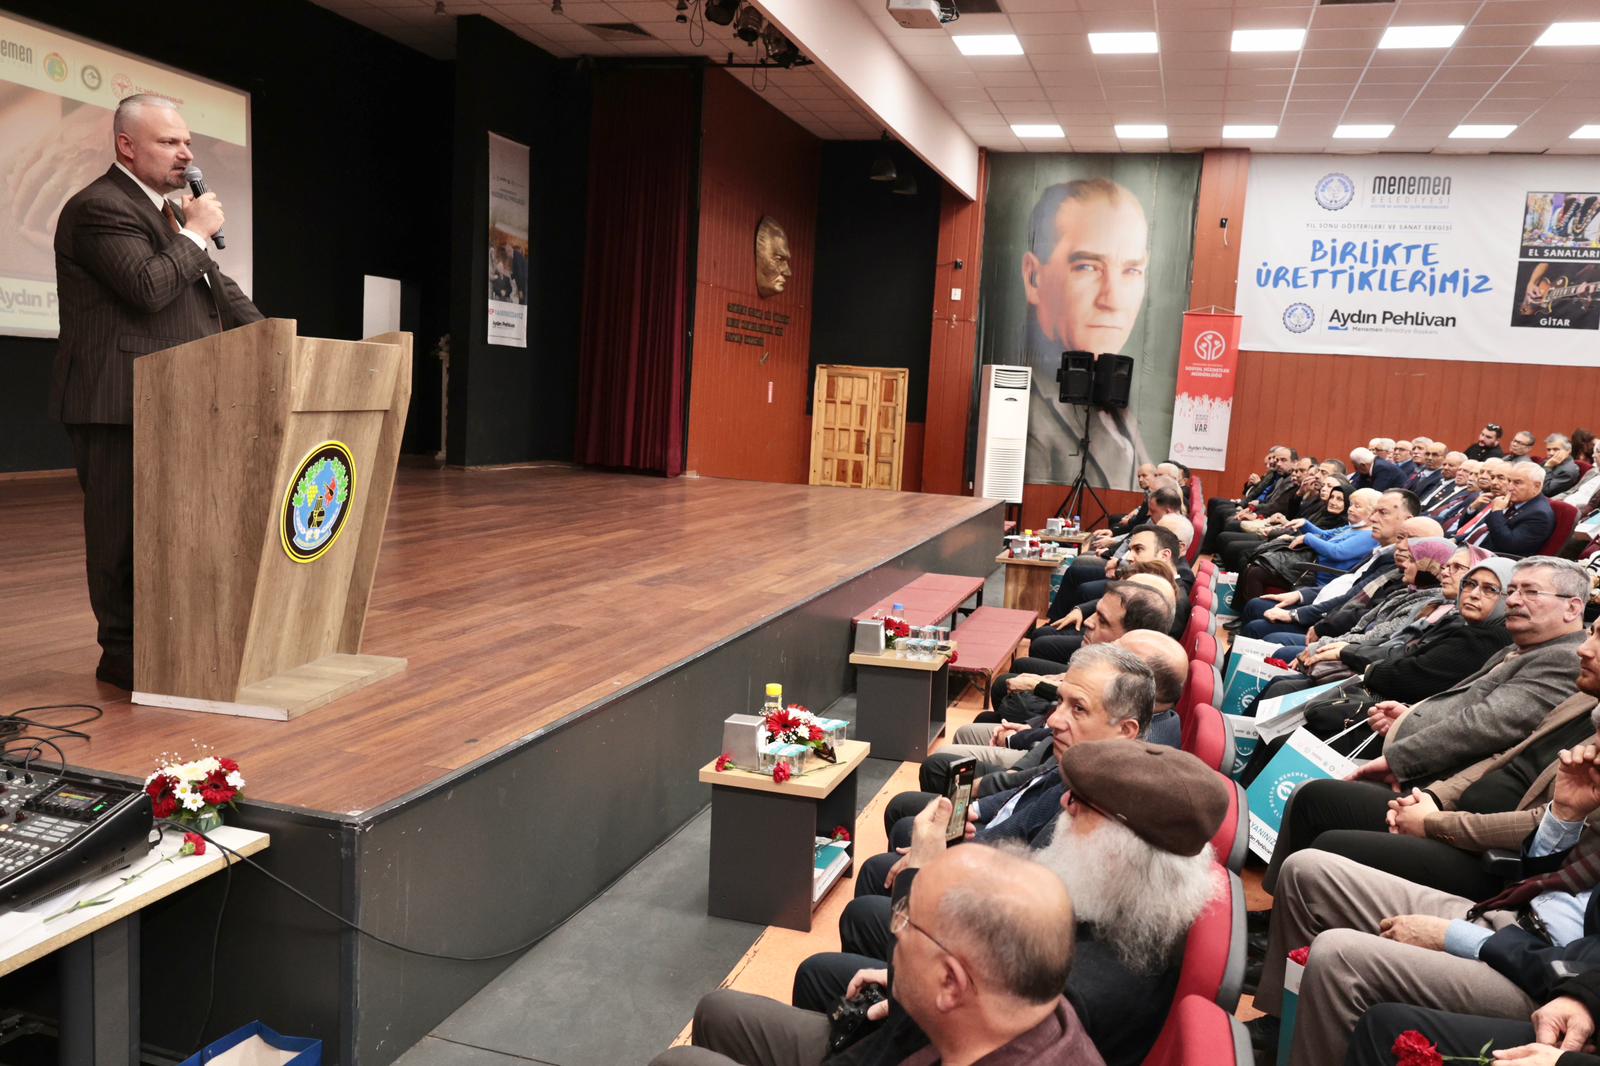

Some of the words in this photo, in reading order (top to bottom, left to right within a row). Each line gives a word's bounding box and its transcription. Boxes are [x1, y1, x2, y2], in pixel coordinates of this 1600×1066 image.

[1372, 175, 1452, 195] menemen
[1319, 222, 1339, 230] SONU
[1388, 223, 1397, 231] VE
[1399, 223, 1421, 232] SANAT
[1310, 238, 1440, 268] BİRLİKTE
[1528, 248, 1540, 257] EL
[1543, 249, 1600, 258] SANATLARI
[1256, 261, 1493, 298] ÜRETTİKLERİMİZ
[1329, 309, 1377, 327] Aydın
[1382, 310, 1457, 328] Pehlivan
[1539, 317, 1571, 327] GİTAR
[1194, 423, 1208, 433] VAR
